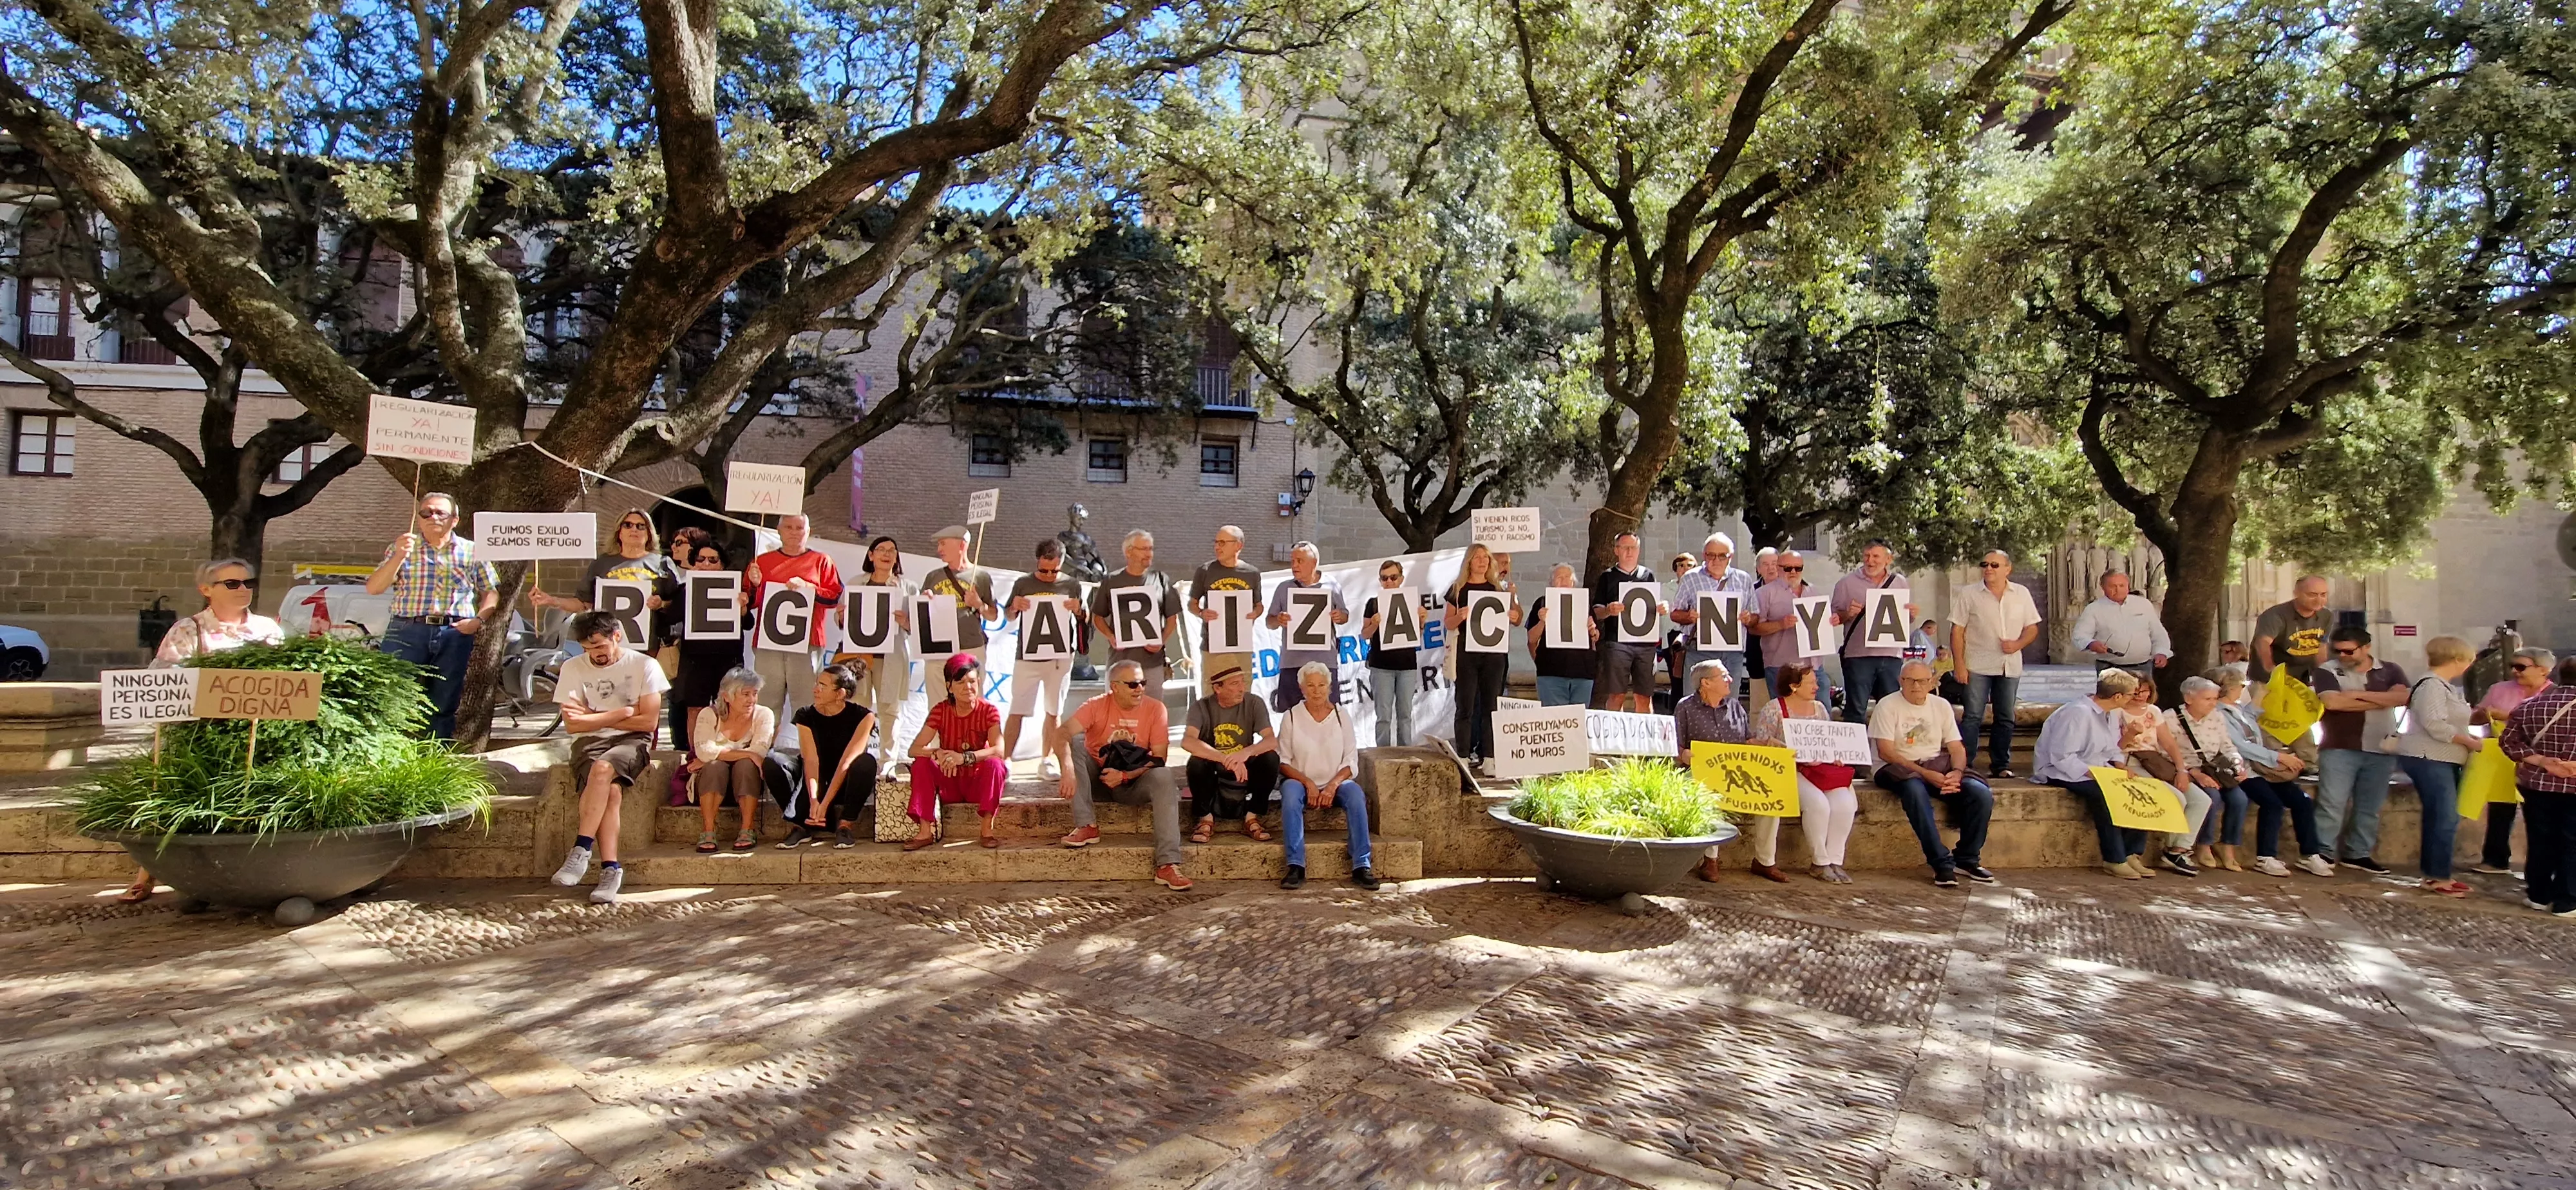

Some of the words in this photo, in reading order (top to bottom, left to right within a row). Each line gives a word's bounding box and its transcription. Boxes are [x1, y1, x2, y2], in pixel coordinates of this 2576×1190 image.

[376, 428, 469, 446] PERMANENTE
[374, 442, 394, 452] SIN
[401, 444, 468, 460] CONDICIONES
[491, 525, 532, 534] FUIMOS
[537, 525, 569, 535] EXILIO
[487, 537, 530, 546] SEAMOS
[536, 538, 582, 547] REFUGIO
[113, 673, 189, 688] NINGUNA
[113, 688, 191, 703] PERSONA
[109, 706, 132, 719] ES
[139, 704, 194, 719] ILEGAL
[1502, 718, 1578, 734] CONSTRUYAMOS
[1586, 715, 1626, 739] COGIDA
[1790, 724, 1801, 734] NO
[1805, 724, 1824, 735] CABE
[1828, 725, 1855, 737] TANTA
[1520, 732, 1564, 745] PUENTES
[1792, 737, 1835, 747] INJUSTICIA
[1511, 749, 1525, 759] NO
[1530, 746, 1565, 757] MUROS
[1796, 750, 1806, 759] EN
[1810, 750, 1828, 760] UNA
[1834, 750, 1866, 761] PATERA
